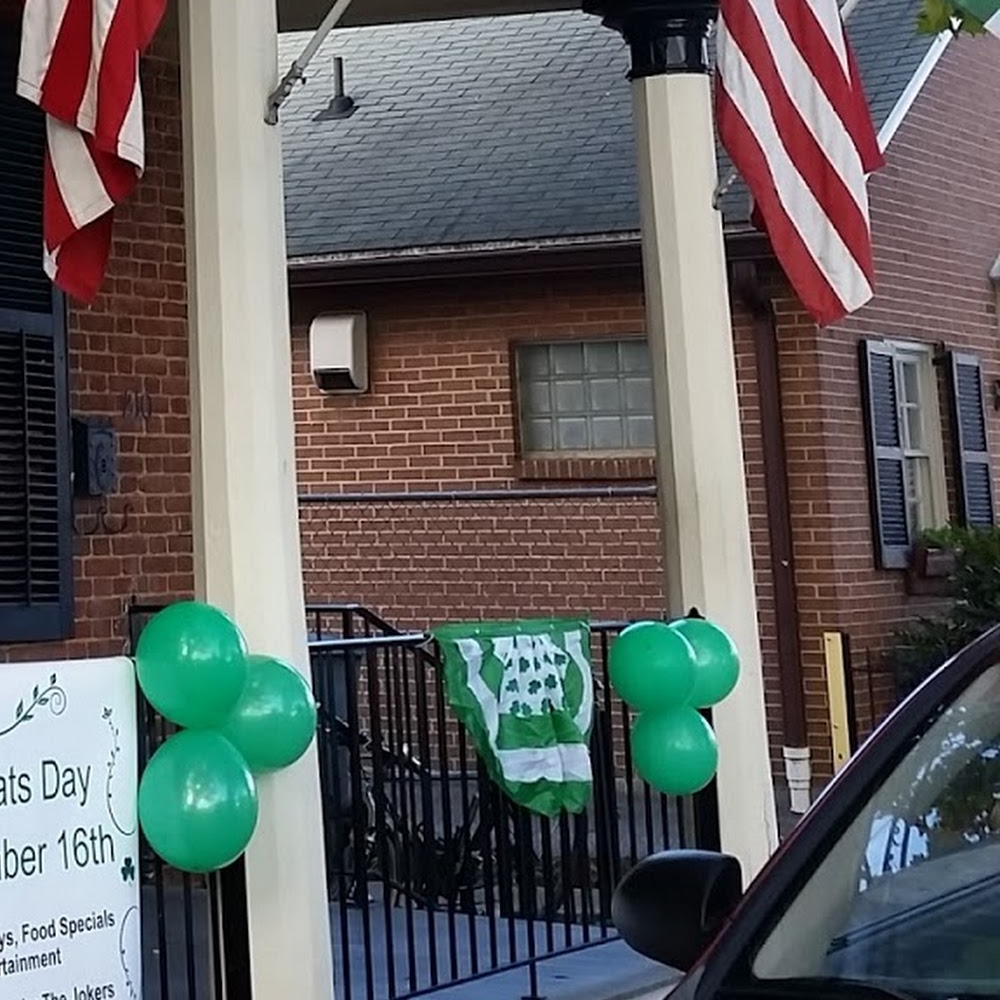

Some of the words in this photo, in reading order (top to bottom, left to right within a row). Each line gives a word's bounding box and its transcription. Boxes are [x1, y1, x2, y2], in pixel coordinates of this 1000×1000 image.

[41, 759, 91, 807] Day
[57, 825, 115, 870] 16th
[21, 918, 56, 943] Food
[59, 909, 116, 939] Specials
[73, 983, 116, 1000] Jokers
